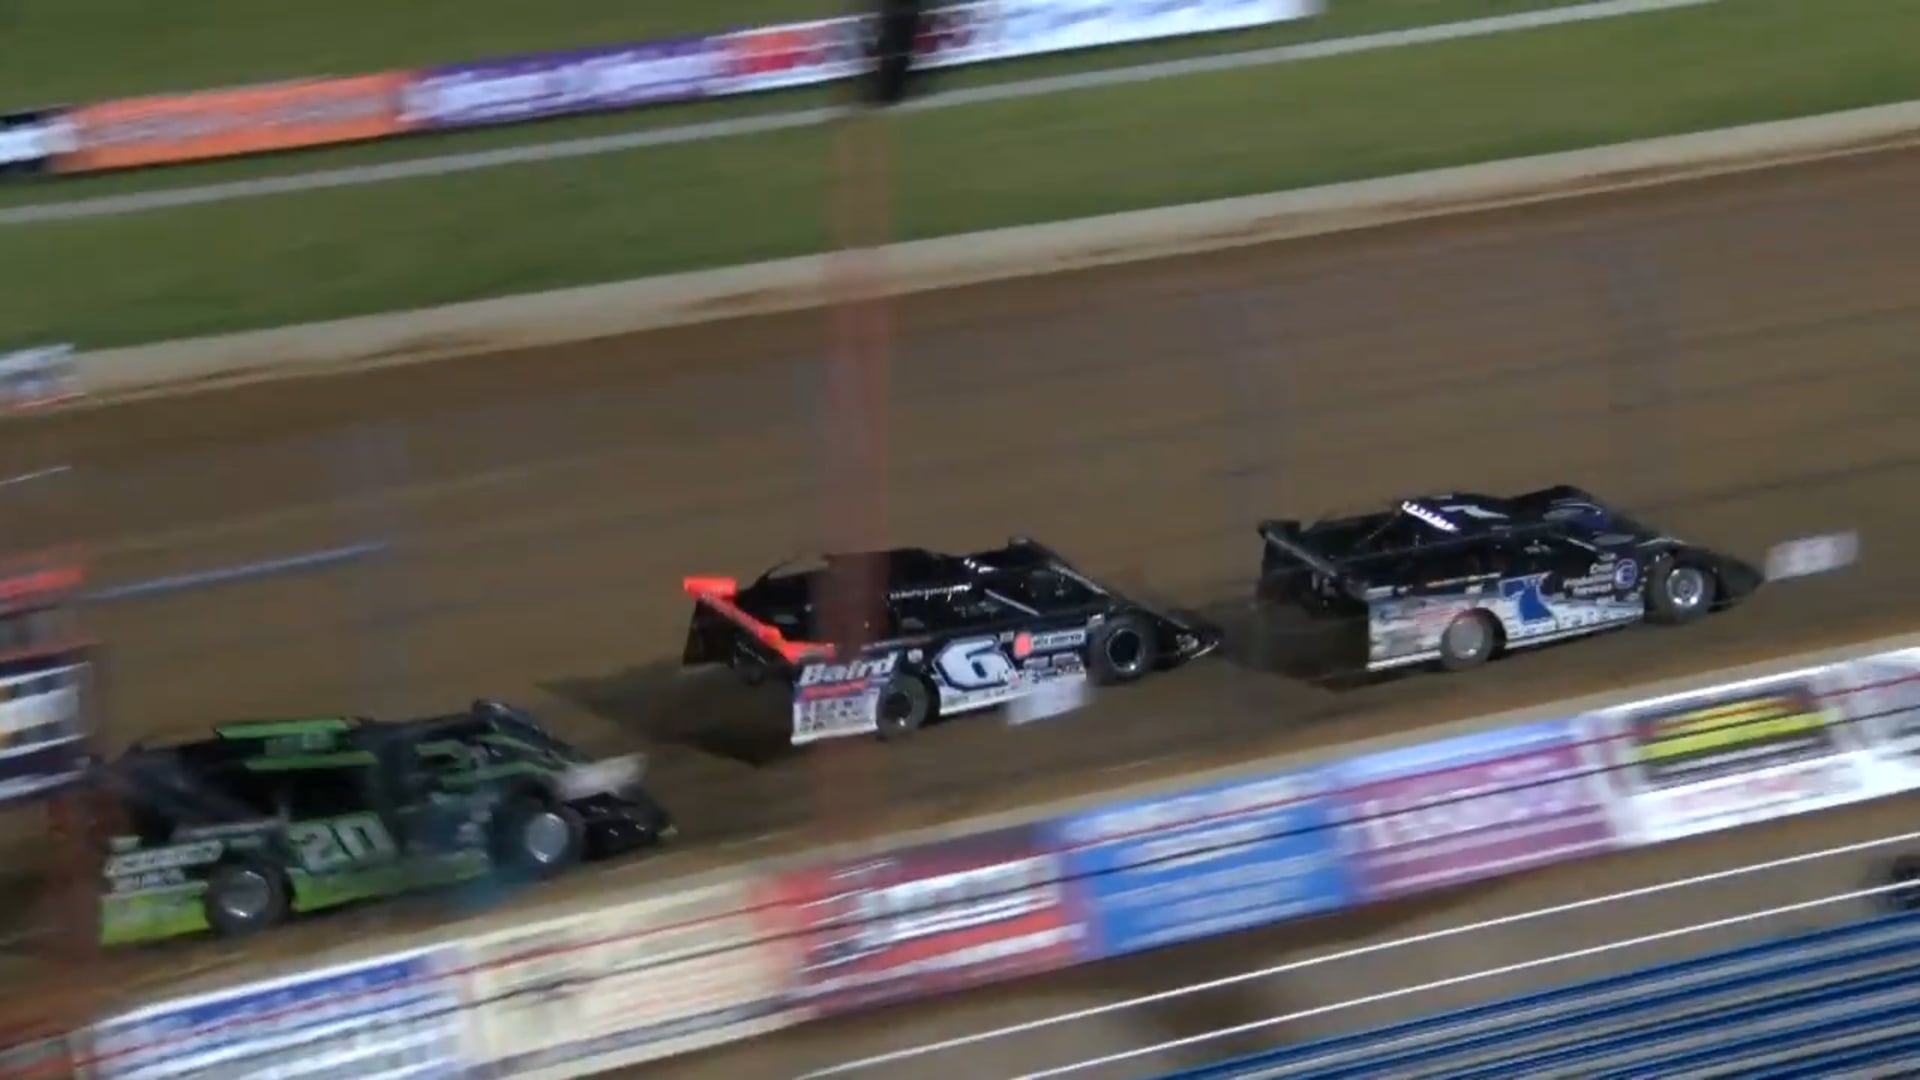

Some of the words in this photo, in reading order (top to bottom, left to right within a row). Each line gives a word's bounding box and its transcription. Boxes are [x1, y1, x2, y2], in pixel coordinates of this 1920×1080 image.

[798, 651, 899, 687] Baird
[933, 636, 1013, 692] 6
[288, 810, 392, 872] 20
